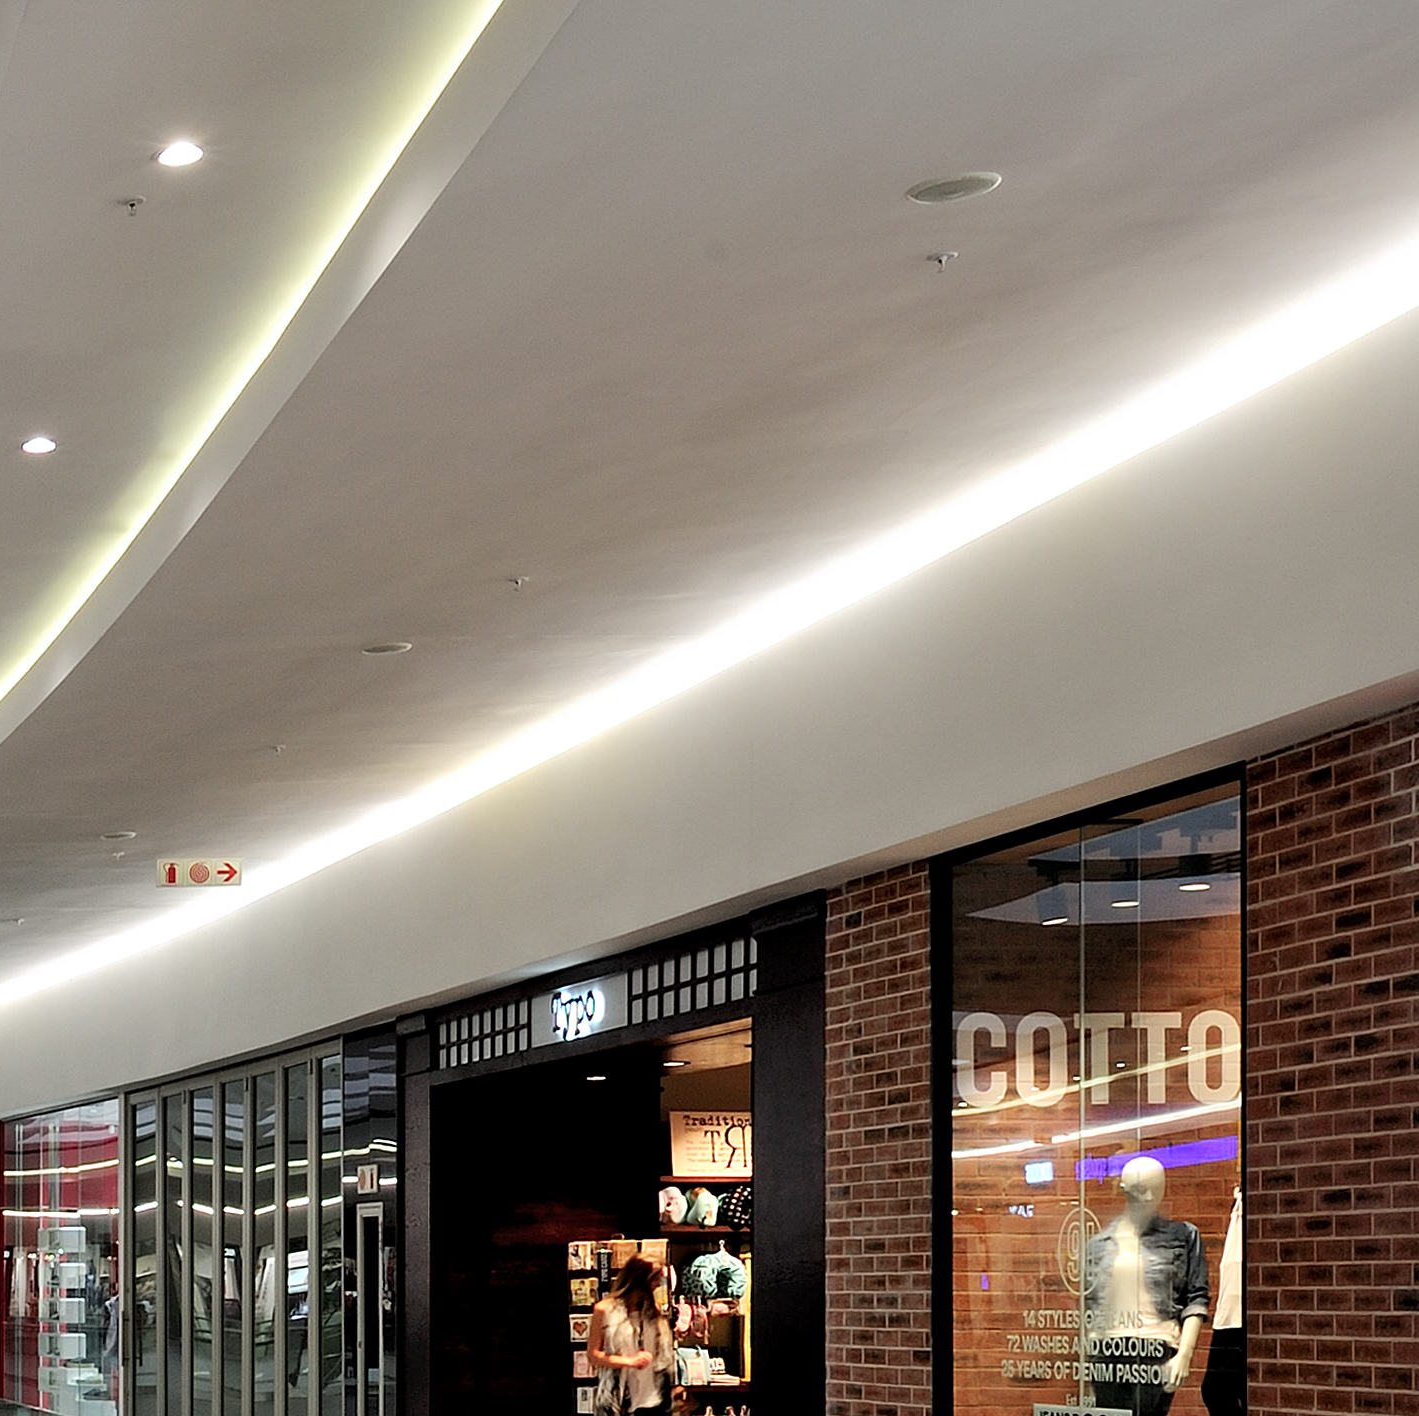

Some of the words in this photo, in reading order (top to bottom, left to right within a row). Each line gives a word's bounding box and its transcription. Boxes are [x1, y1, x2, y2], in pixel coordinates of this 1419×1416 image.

[956, 1010, 1241, 1106] COTTO
[1023, 1310, 1036, 1328] 14
[1038, 1310, 1080, 1329] STYLES
[1007, 1335, 1020, 1353] 72
[1022, 1335, 1070, 1355] WASHES
[1072, 1337, 1101, 1356] AND
[1102, 1338, 1164, 1358] COLOURS
[1017, 1360, 1052, 1379] YEARS
[1054, 1361, 1071, 1380] OF
[1072, 1362, 1114, 1383] DENIM
